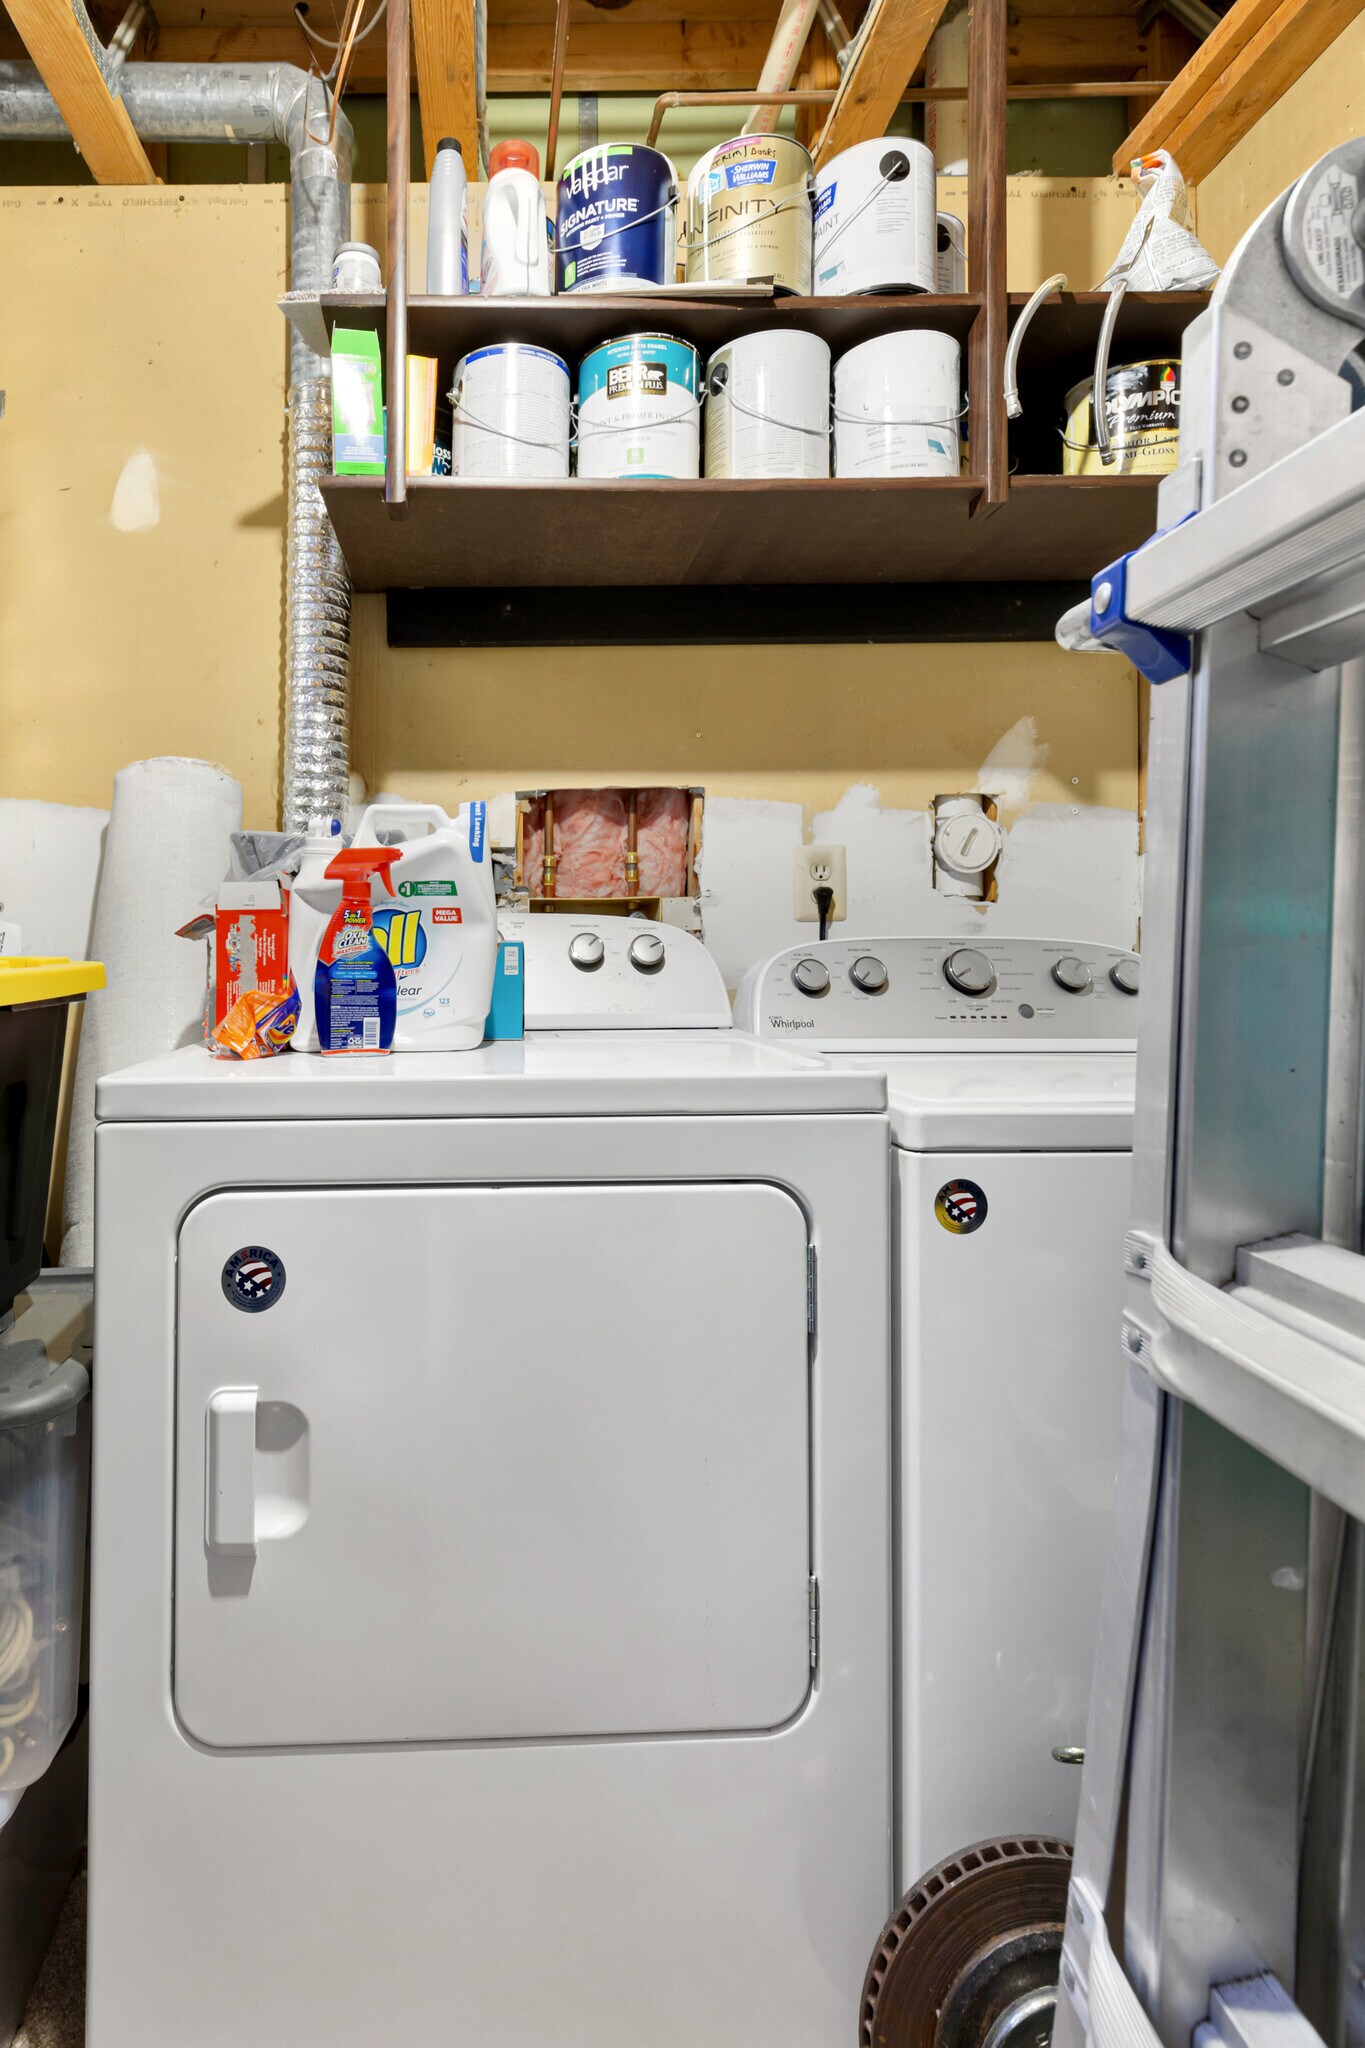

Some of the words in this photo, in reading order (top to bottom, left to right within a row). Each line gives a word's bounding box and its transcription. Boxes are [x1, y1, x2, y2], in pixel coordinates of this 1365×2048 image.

[731, 162, 770, 176] SHERWIN
[732, 171, 769, 184] WILLIAMS
[122, 198, 179, 207] FIRESHIELD
[559, 197, 638, 239] SIGNATURE
[608, 365, 648, 387] BER
[608, 380, 645, 395] PREMM
[432, 443, 452, 461] loss
[1124, 447, 1175, 460] MI-GLOSS
[343, 909, 351, 919] 5
[434, 915, 459, 923] VALUE
[344, 930, 362, 941] OXI
[337, 937, 367, 949] CLEAN
[393, 968, 420, 981] ifters
[396, 985, 423, 996] lear
[770, 1019, 815, 1030] Whirlpool
[224, 1247, 280, 1280] AMERICA
